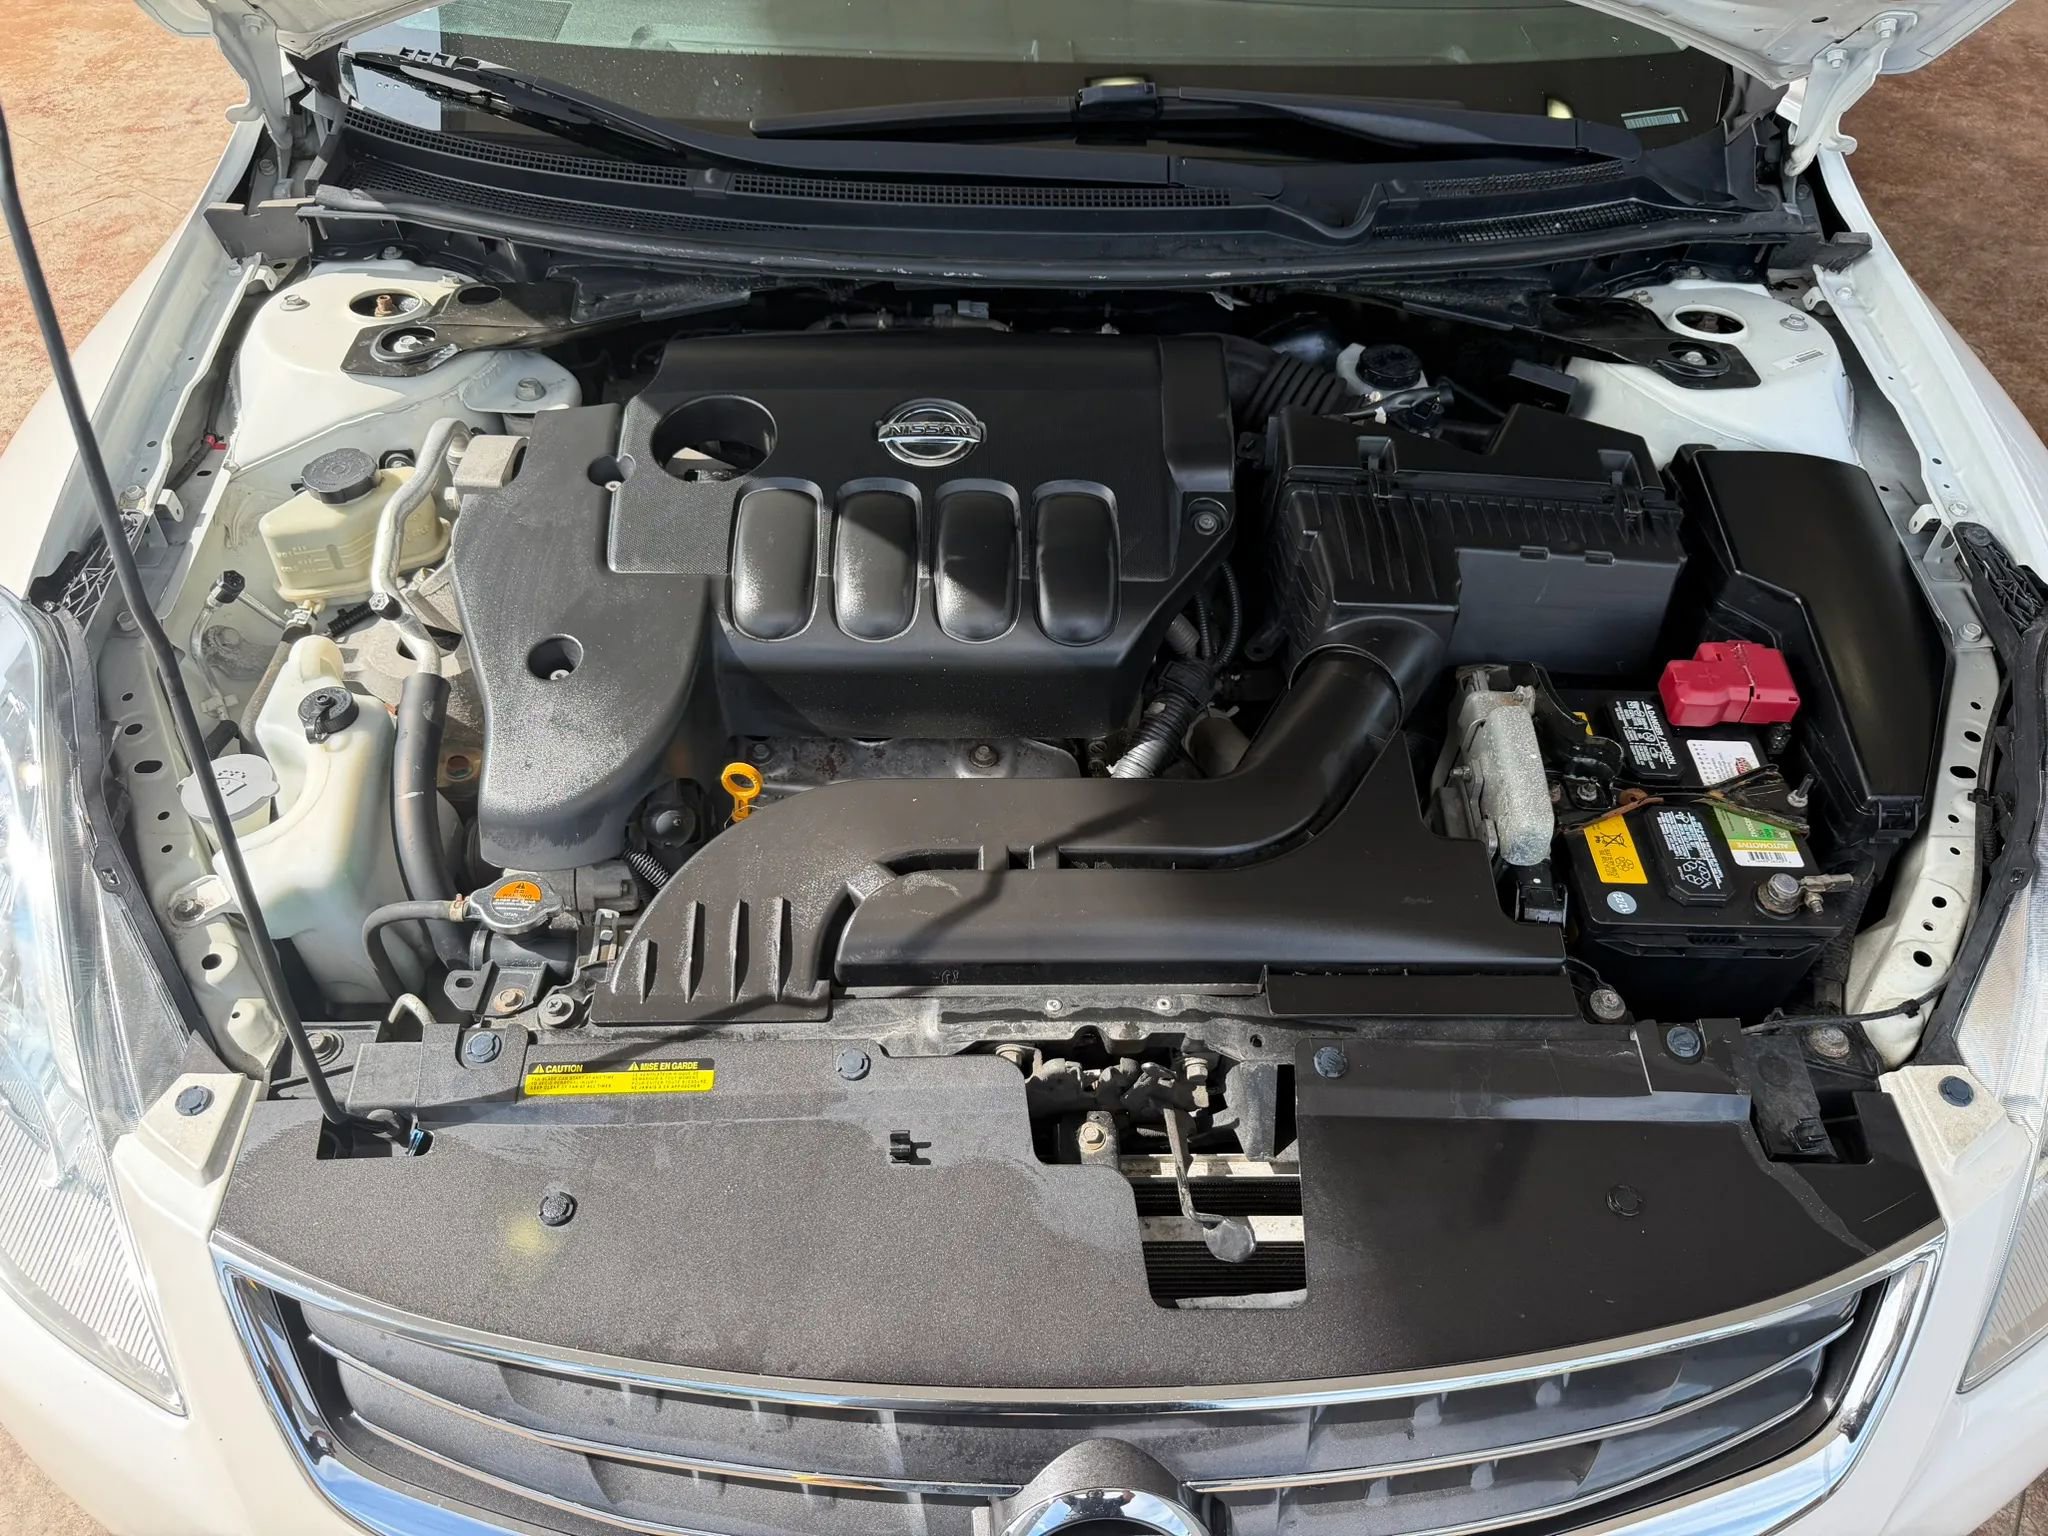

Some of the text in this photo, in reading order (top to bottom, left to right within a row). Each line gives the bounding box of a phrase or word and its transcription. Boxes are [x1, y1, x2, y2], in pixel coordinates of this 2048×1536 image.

[888, 424, 971, 436] NISSAN
[1647, 710, 1664, 736] DANGER
[1660, 741, 1677, 765] POISON
[1736, 841, 1789, 849] AUTOMOTIVE
[1612, 893, 1631, 913] 12/22
[545, 1064, 583, 1073] CAUTION
[640, 1061, 699, 1071] MISE EN GARDE
